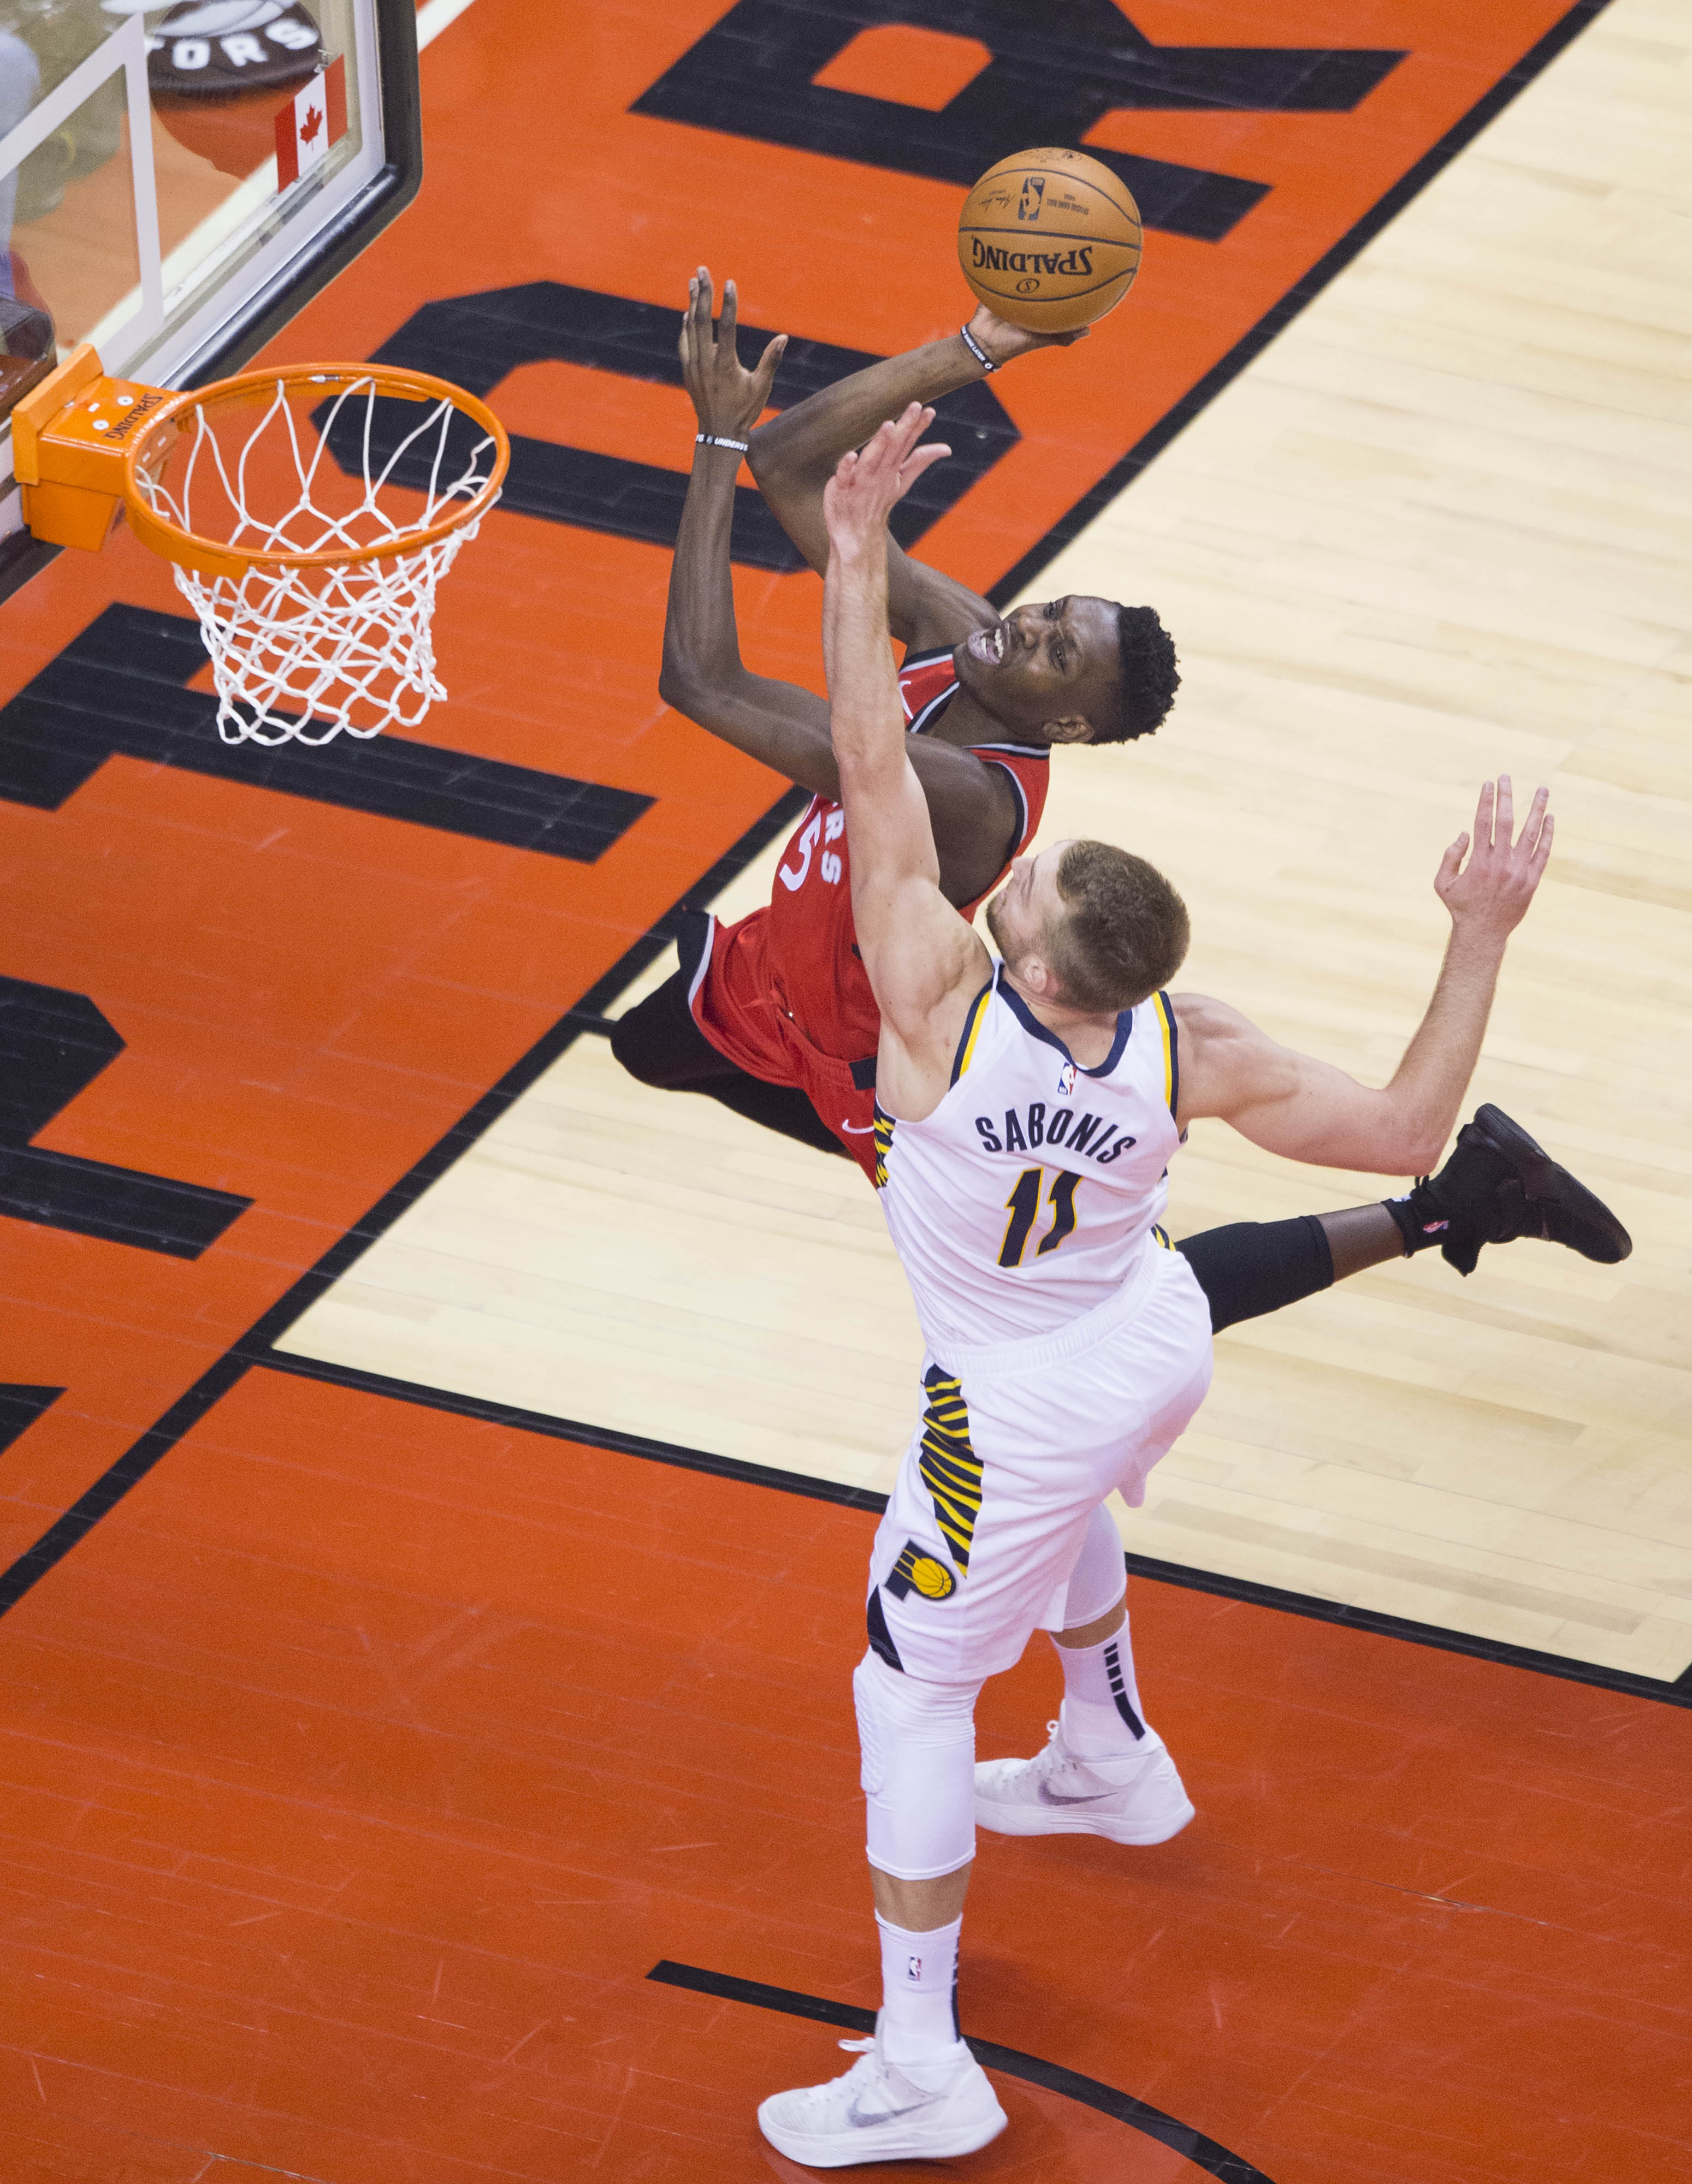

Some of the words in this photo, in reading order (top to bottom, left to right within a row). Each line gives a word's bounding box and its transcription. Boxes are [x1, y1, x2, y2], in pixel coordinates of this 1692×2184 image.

[972, 237, 1092, 276] SPALDING
[104, 393, 163, 440] SPALDING
[779, 810, 821, 892] 5
[821, 801, 844, 885] RS
[975, 1102, 1137, 1164] SABONIS
[998, 1166, 1084, 1268] 11
